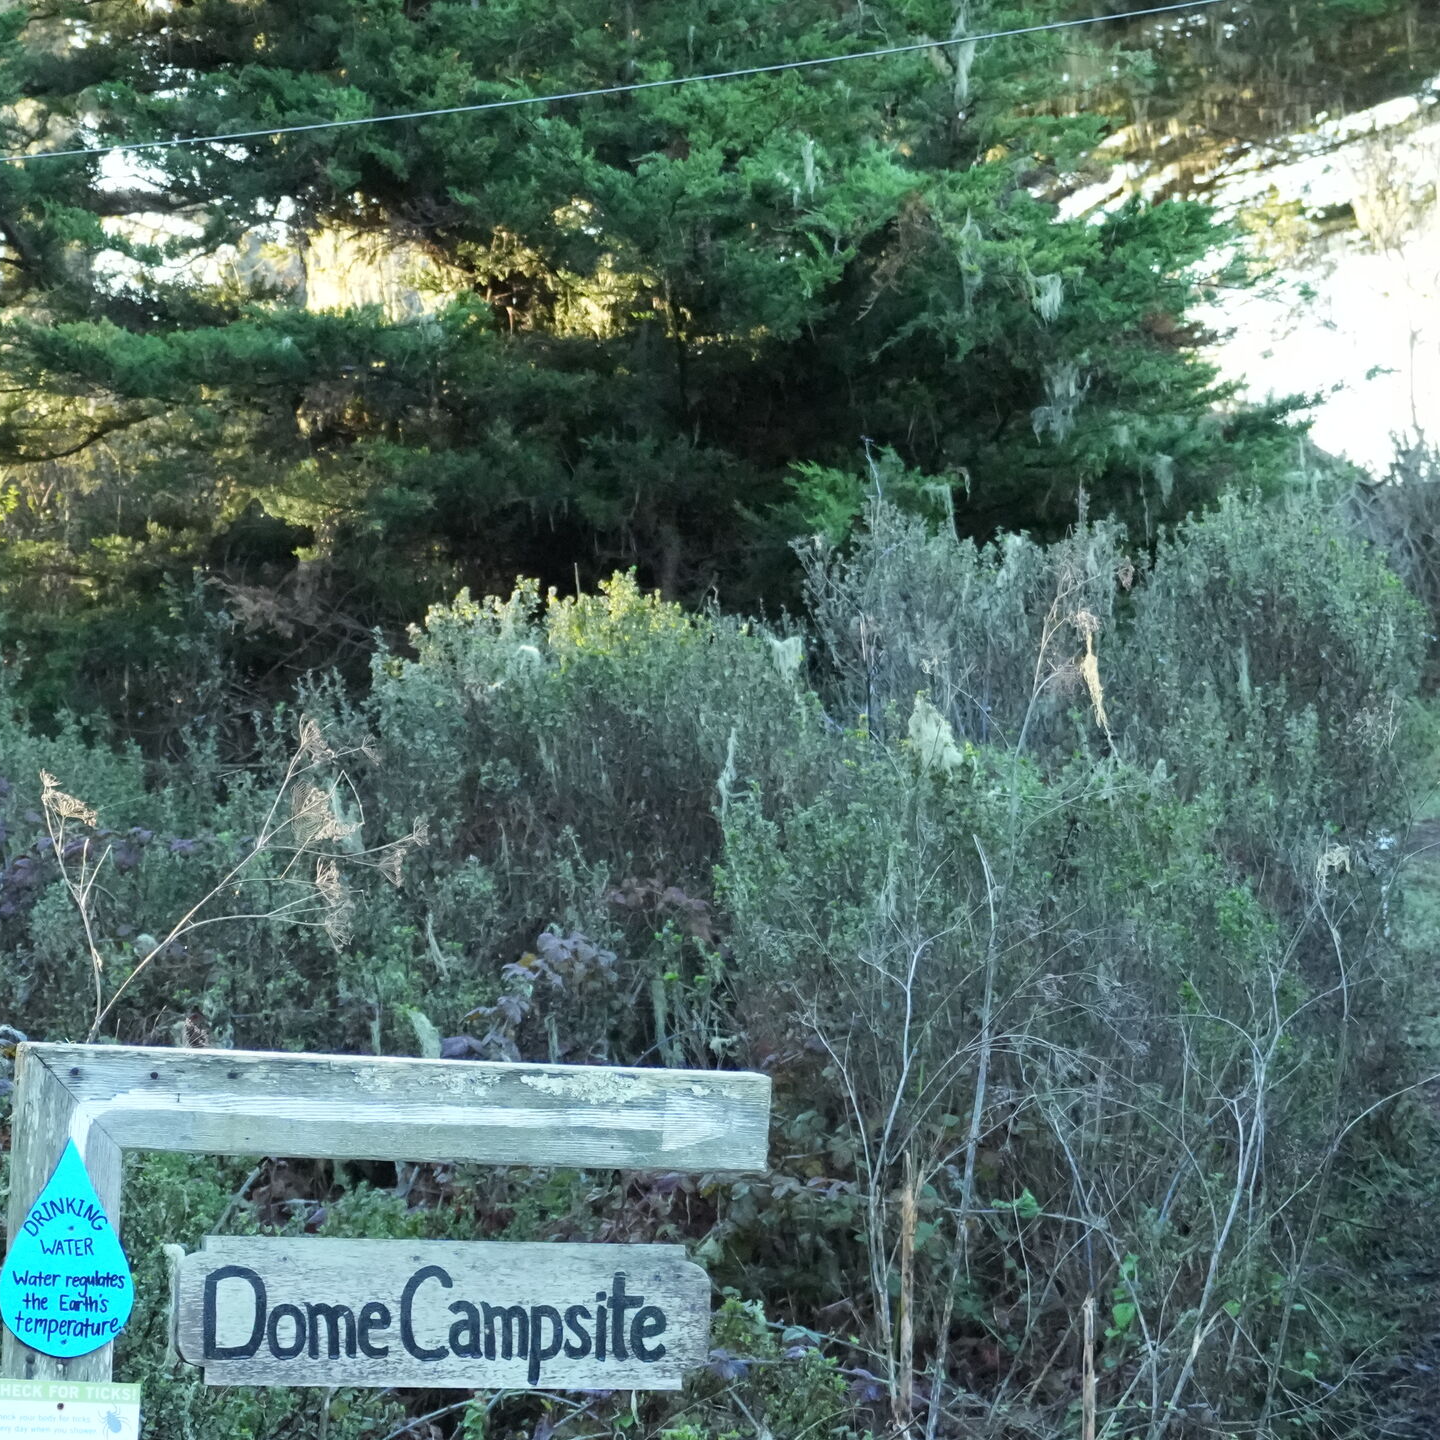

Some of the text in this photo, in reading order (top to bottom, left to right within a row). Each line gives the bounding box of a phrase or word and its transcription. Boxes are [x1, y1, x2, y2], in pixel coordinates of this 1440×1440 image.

[23, 1197, 108, 1237] DRINKING
[40, 1237, 94, 1256] WATER
[12, 1270, 126, 1297] Water regulates
[22, 1292, 109, 1312] the Earth's
[203, 1265, 667, 1385] Dome Campsite
[48, 1385, 80, 1399] FOR
[85, 1386, 137, 1401] TICKS!
[19, 1415, 36, 1423] your
[38, 1413, 57, 1423] body
[58, 1414, 70, 1422] for
[14, 1425, 28, 1434] day
[53, 1427, 67, 1435] you
